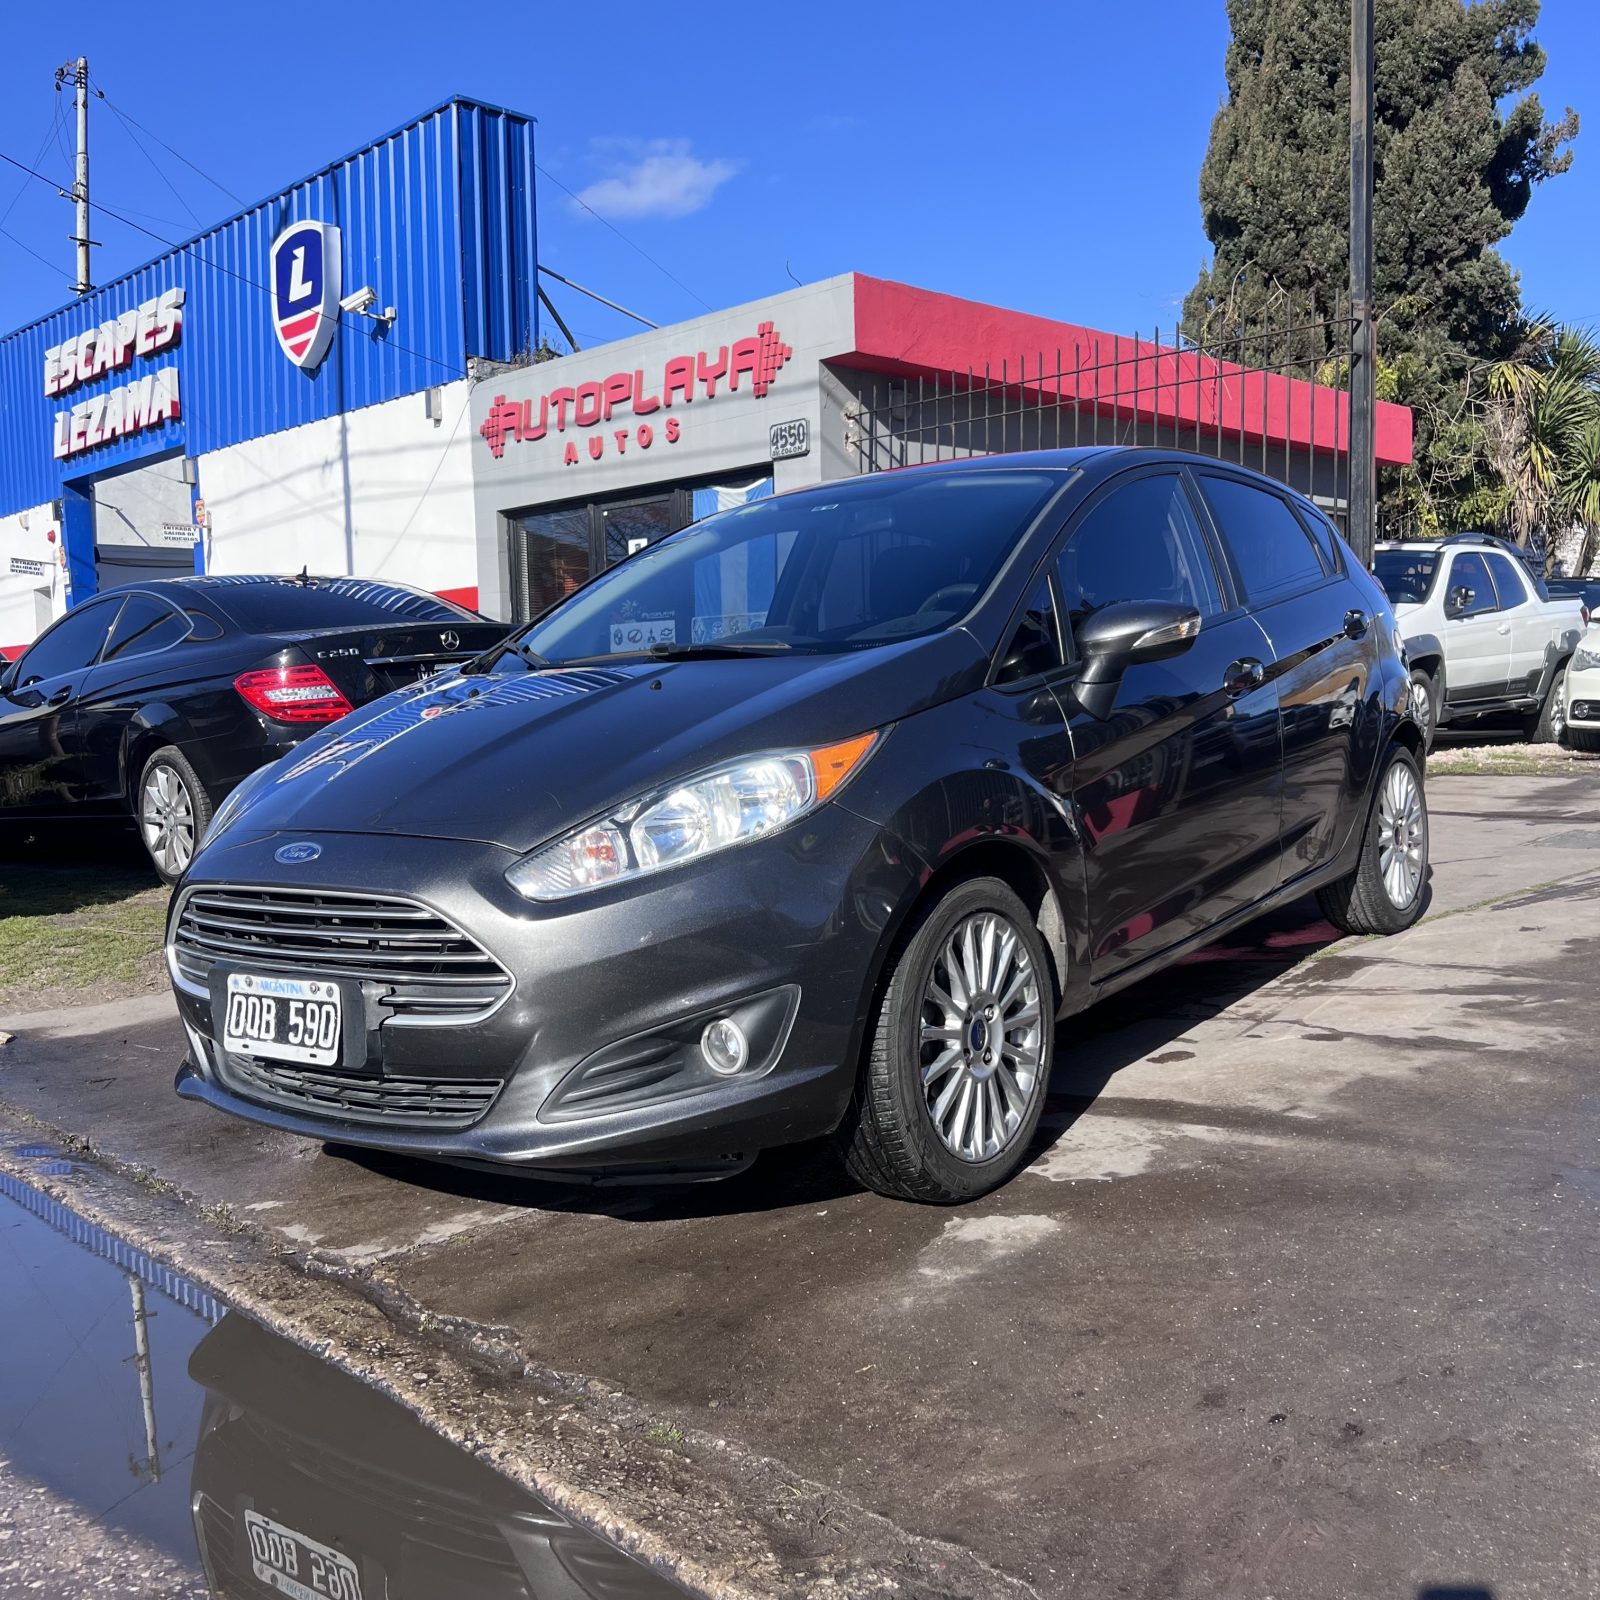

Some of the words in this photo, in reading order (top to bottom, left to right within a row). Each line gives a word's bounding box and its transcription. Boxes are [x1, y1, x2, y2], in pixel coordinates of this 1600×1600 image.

[44, 287, 186, 397] ESCAPES
[54, 366, 181, 458] LEZAMA
[498, 337, 764, 446] AUTOPLAYA
[563, 417, 680, 466] AUTOS
[771, 422, 805, 450] 4550
[329, 647, 360, 659] 250
[260, 980, 304, 995] ARGENTINA
[229, 994, 277, 1040] OQB
[288, 1000, 336, 1049] 590
